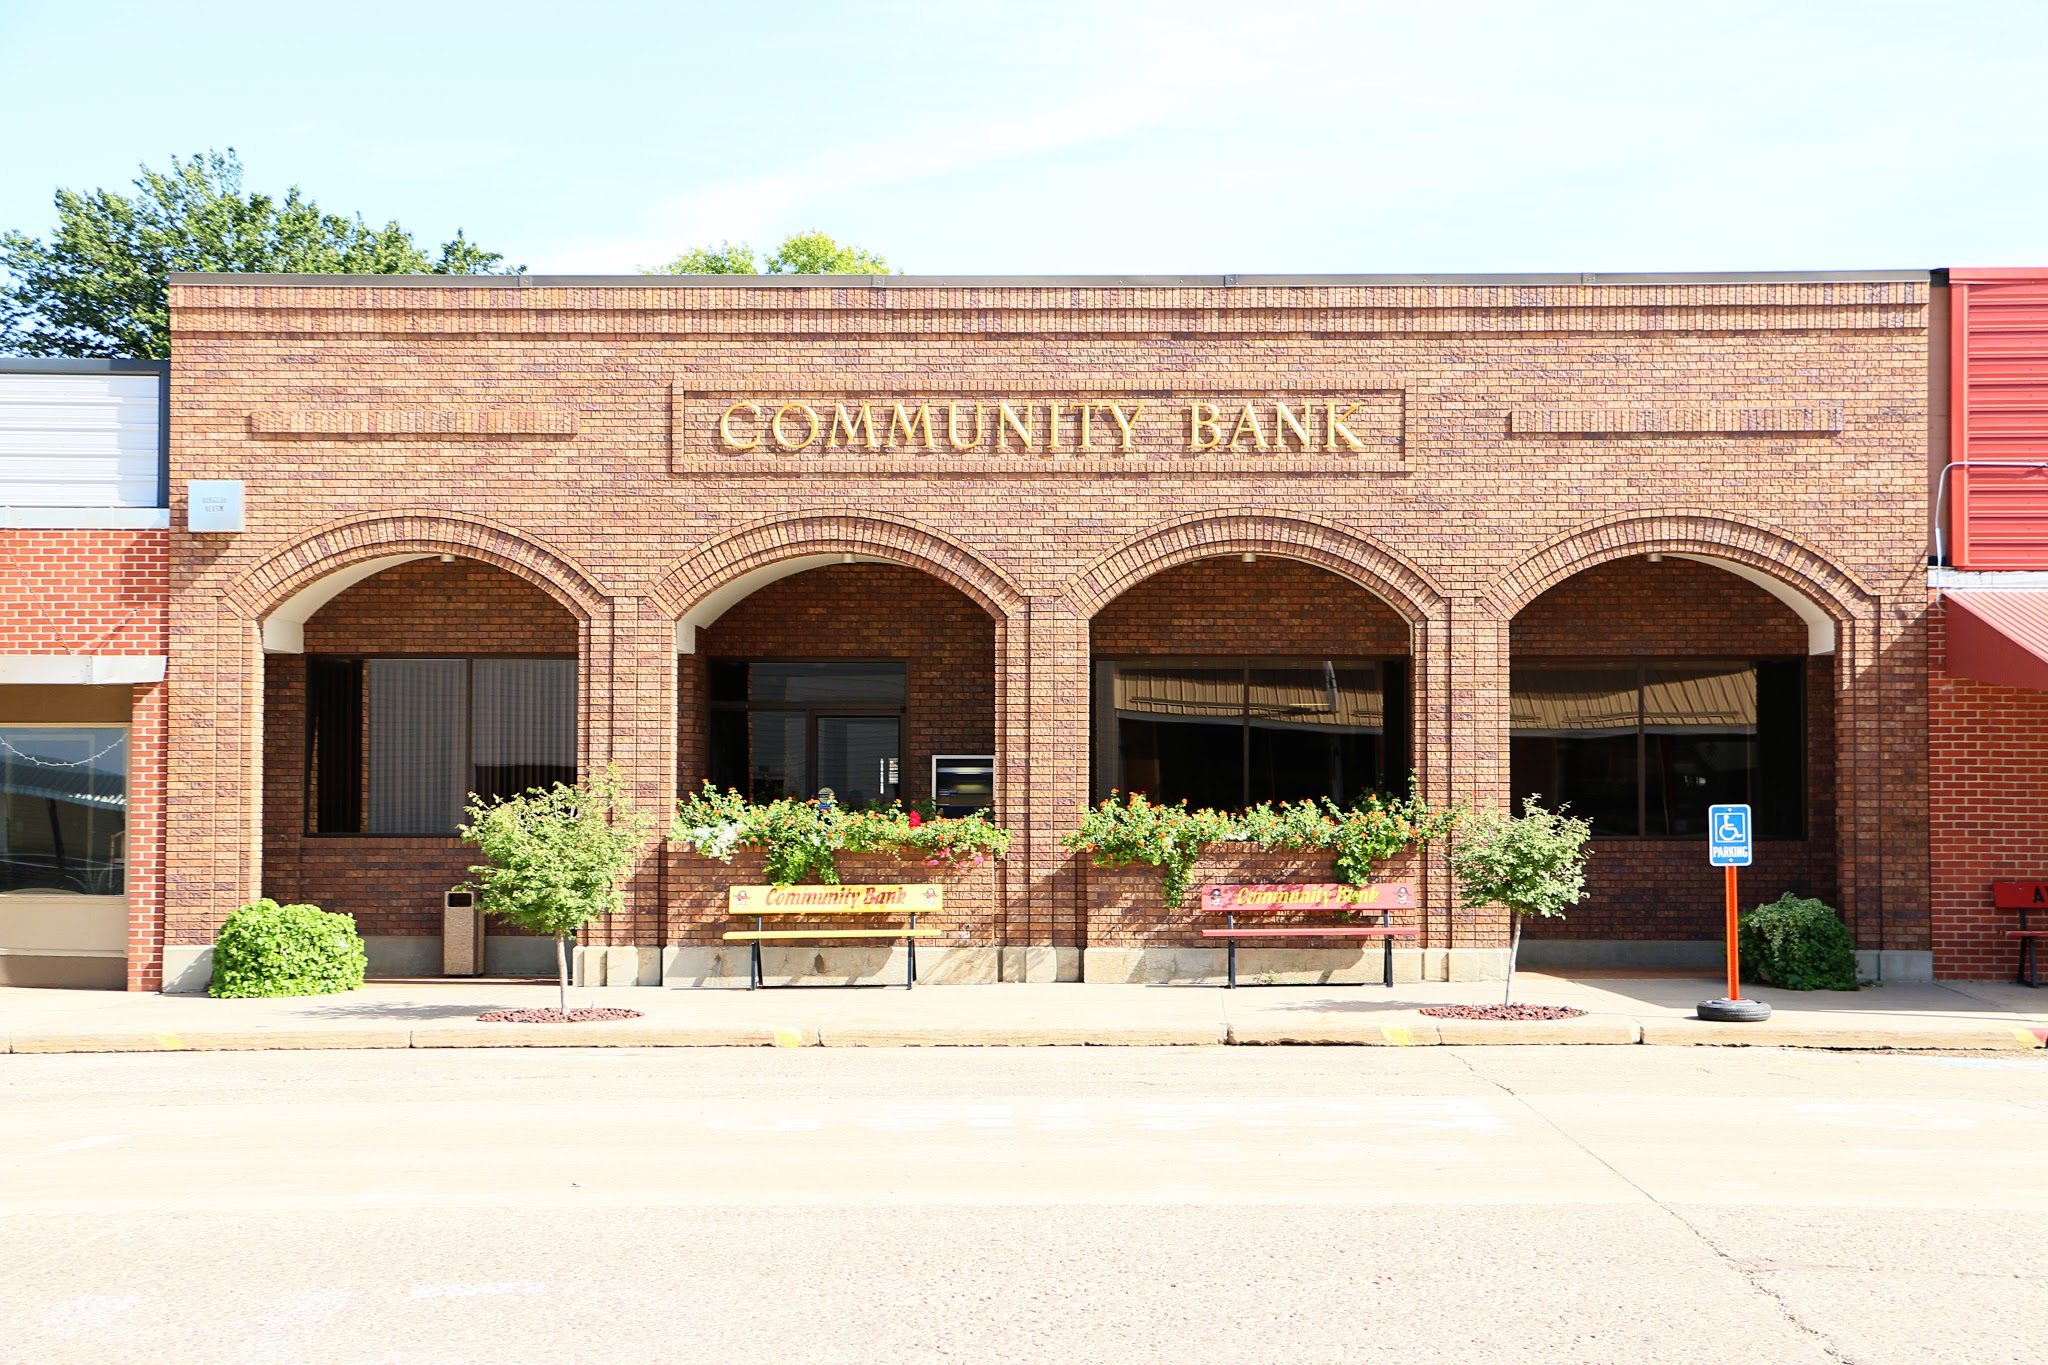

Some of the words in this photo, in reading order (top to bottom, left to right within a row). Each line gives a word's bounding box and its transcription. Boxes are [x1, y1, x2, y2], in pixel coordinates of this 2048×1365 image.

[720, 401, 1146, 450] COMMUNITY
[1188, 401, 1367, 450] BANK
[1712, 845, 1749, 858] PARKING
[765, 886, 860, 908] Community
[863, 886, 907, 905] Bank
[1236, 885, 1333, 908] Community
